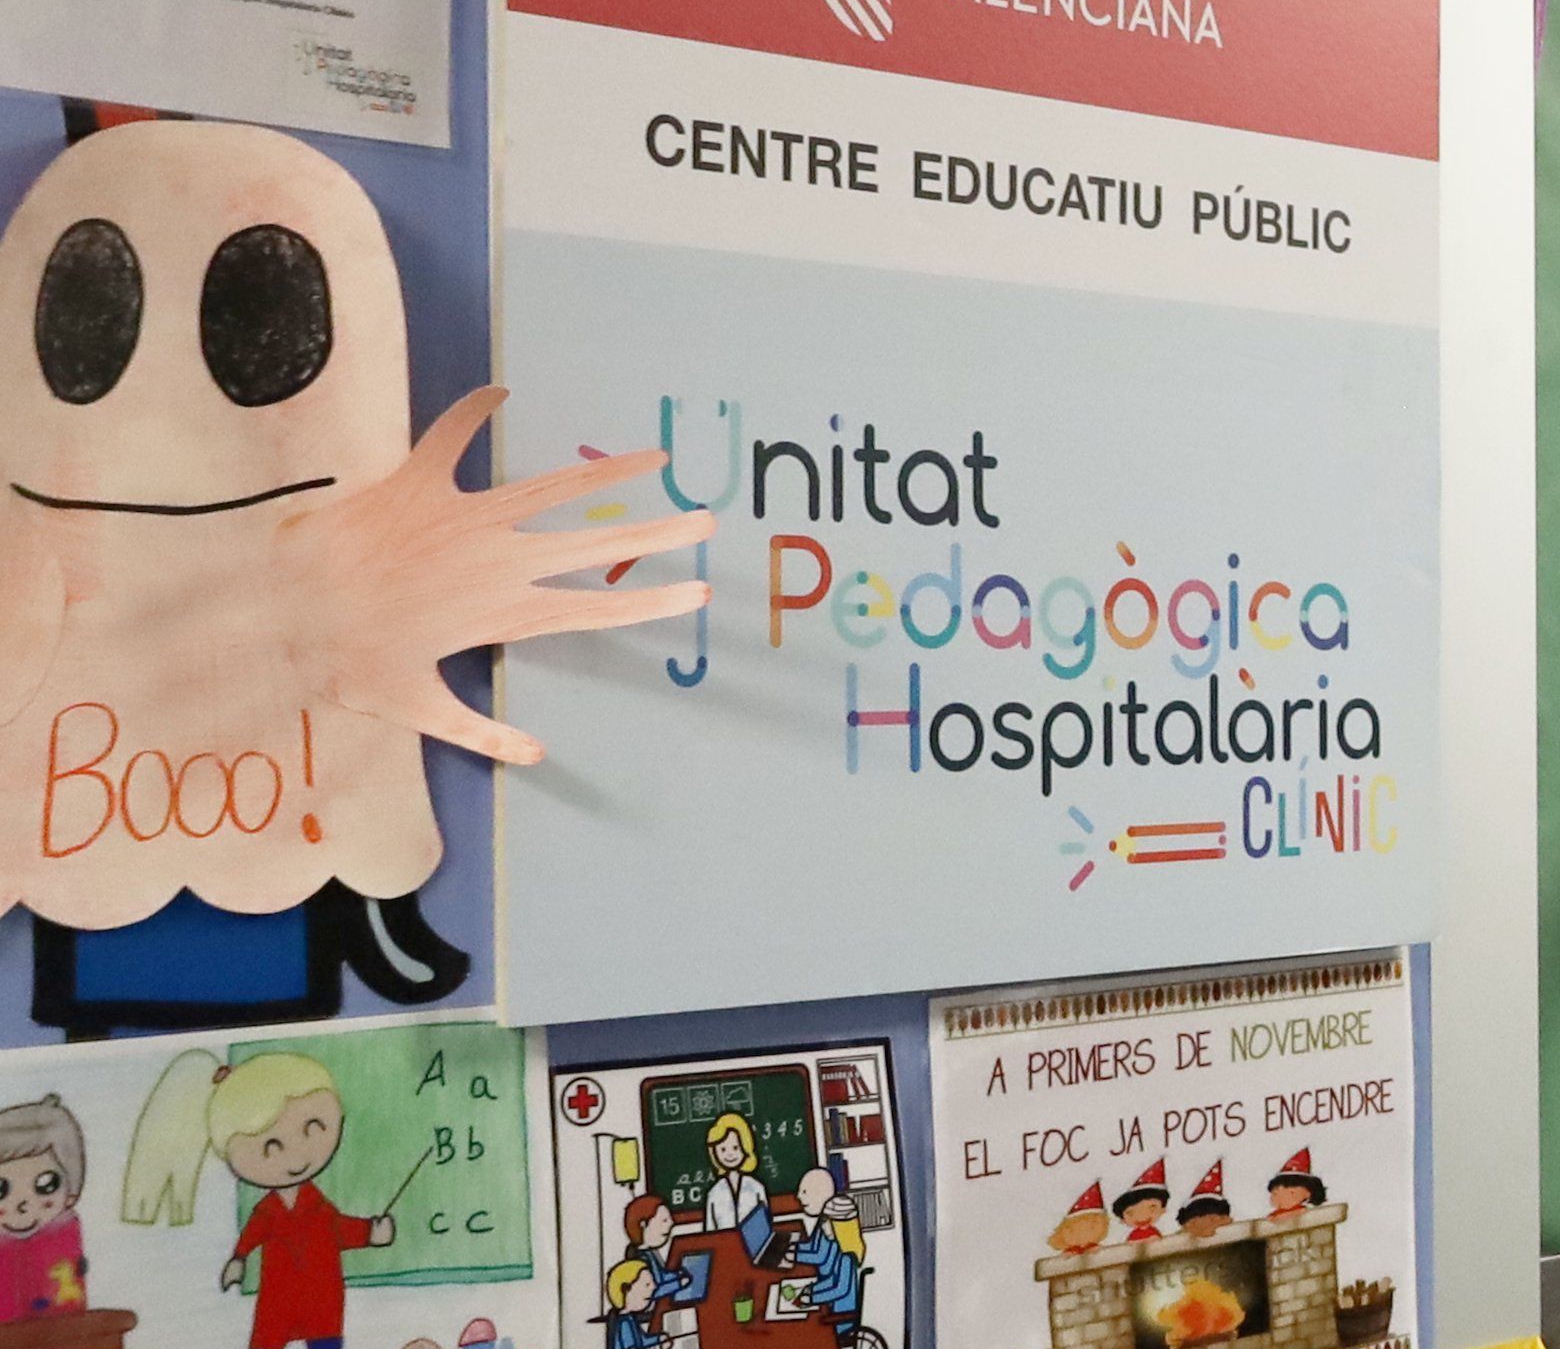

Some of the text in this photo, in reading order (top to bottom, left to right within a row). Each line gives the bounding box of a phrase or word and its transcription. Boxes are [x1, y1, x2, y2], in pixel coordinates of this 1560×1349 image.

[645, 113, 1353, 254] CENTRE EDUCATIU PÚBLIC
[660, 394, 1000, 529] Unitat
[769, 534, 1349, 680] Pedagògica
[846, 663, 1382, 798] Hospitalària
[41, 702, 324, 858] Booo!
[416, 1050, 498, 1101] A a
[986, 1010, 1373, 1096] A PRIMERS DE NOVEMBRE
[434, 1125, 485, 1165] B b
[660, 1097, 680, 1117] 15
[777, 1120, 788, 1138] 4
[963, 1078, 1395, 1180] EL FOC JA POTS ENCENDRE
[671, 1186, 702, 1205] B C
